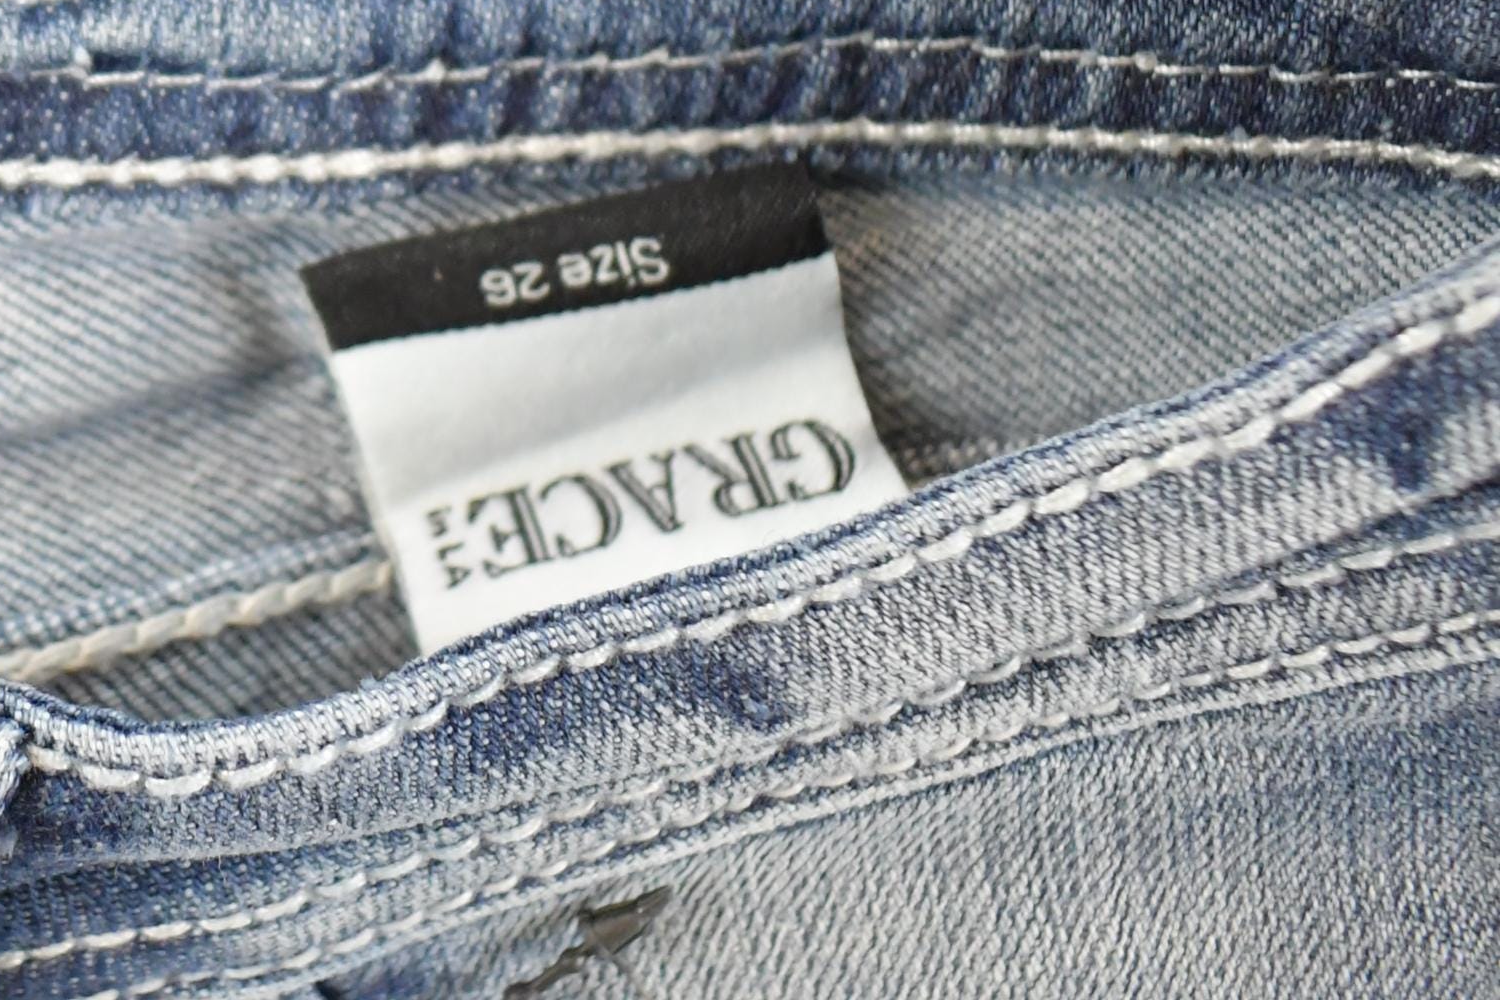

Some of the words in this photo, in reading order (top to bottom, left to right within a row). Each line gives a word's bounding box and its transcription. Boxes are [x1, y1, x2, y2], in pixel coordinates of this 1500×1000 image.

[479, 260, 550, 308] 26
[557, 236, 671, 288] Size
[467, 419, 855, 578] GRACE
